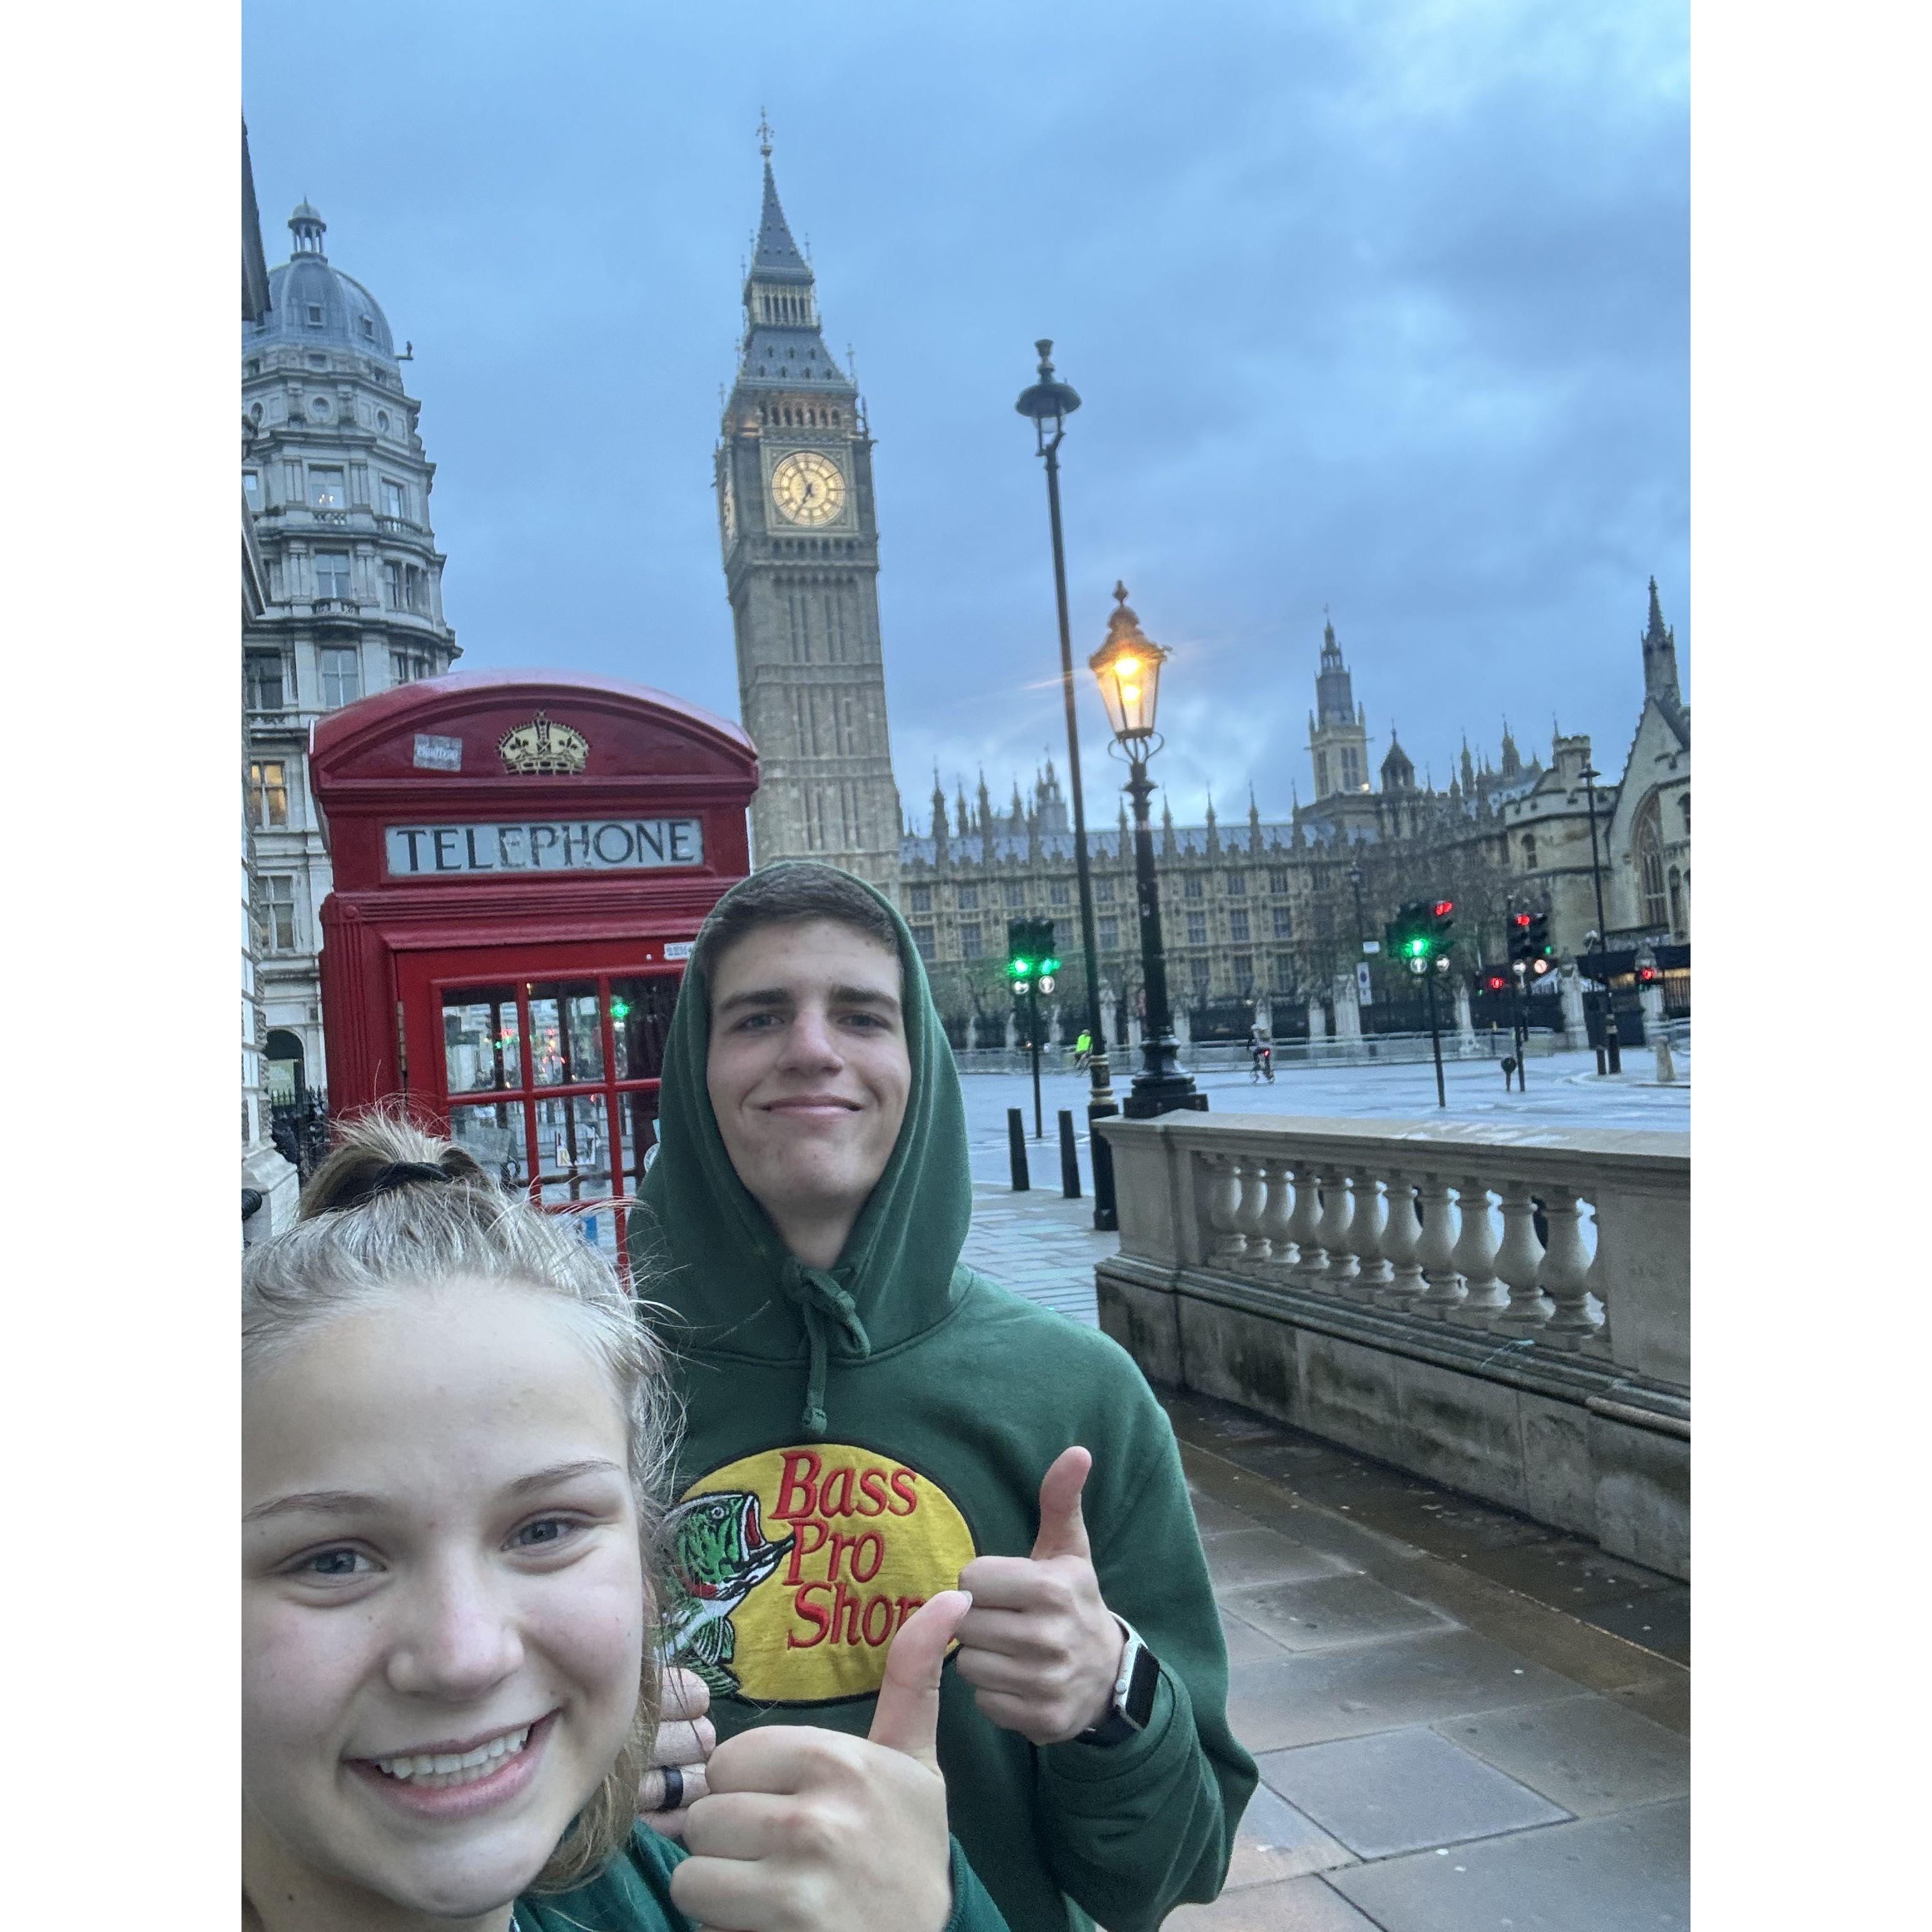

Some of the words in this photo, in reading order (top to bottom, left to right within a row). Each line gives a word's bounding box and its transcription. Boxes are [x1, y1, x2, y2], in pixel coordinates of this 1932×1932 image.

[397, 821, 694, 872] TELEPHONE
[770, 1450, 917, 1520] Bass
[782, 1519, 884, 1585] Pro
[786, 1582, 927, 1650] Sho
